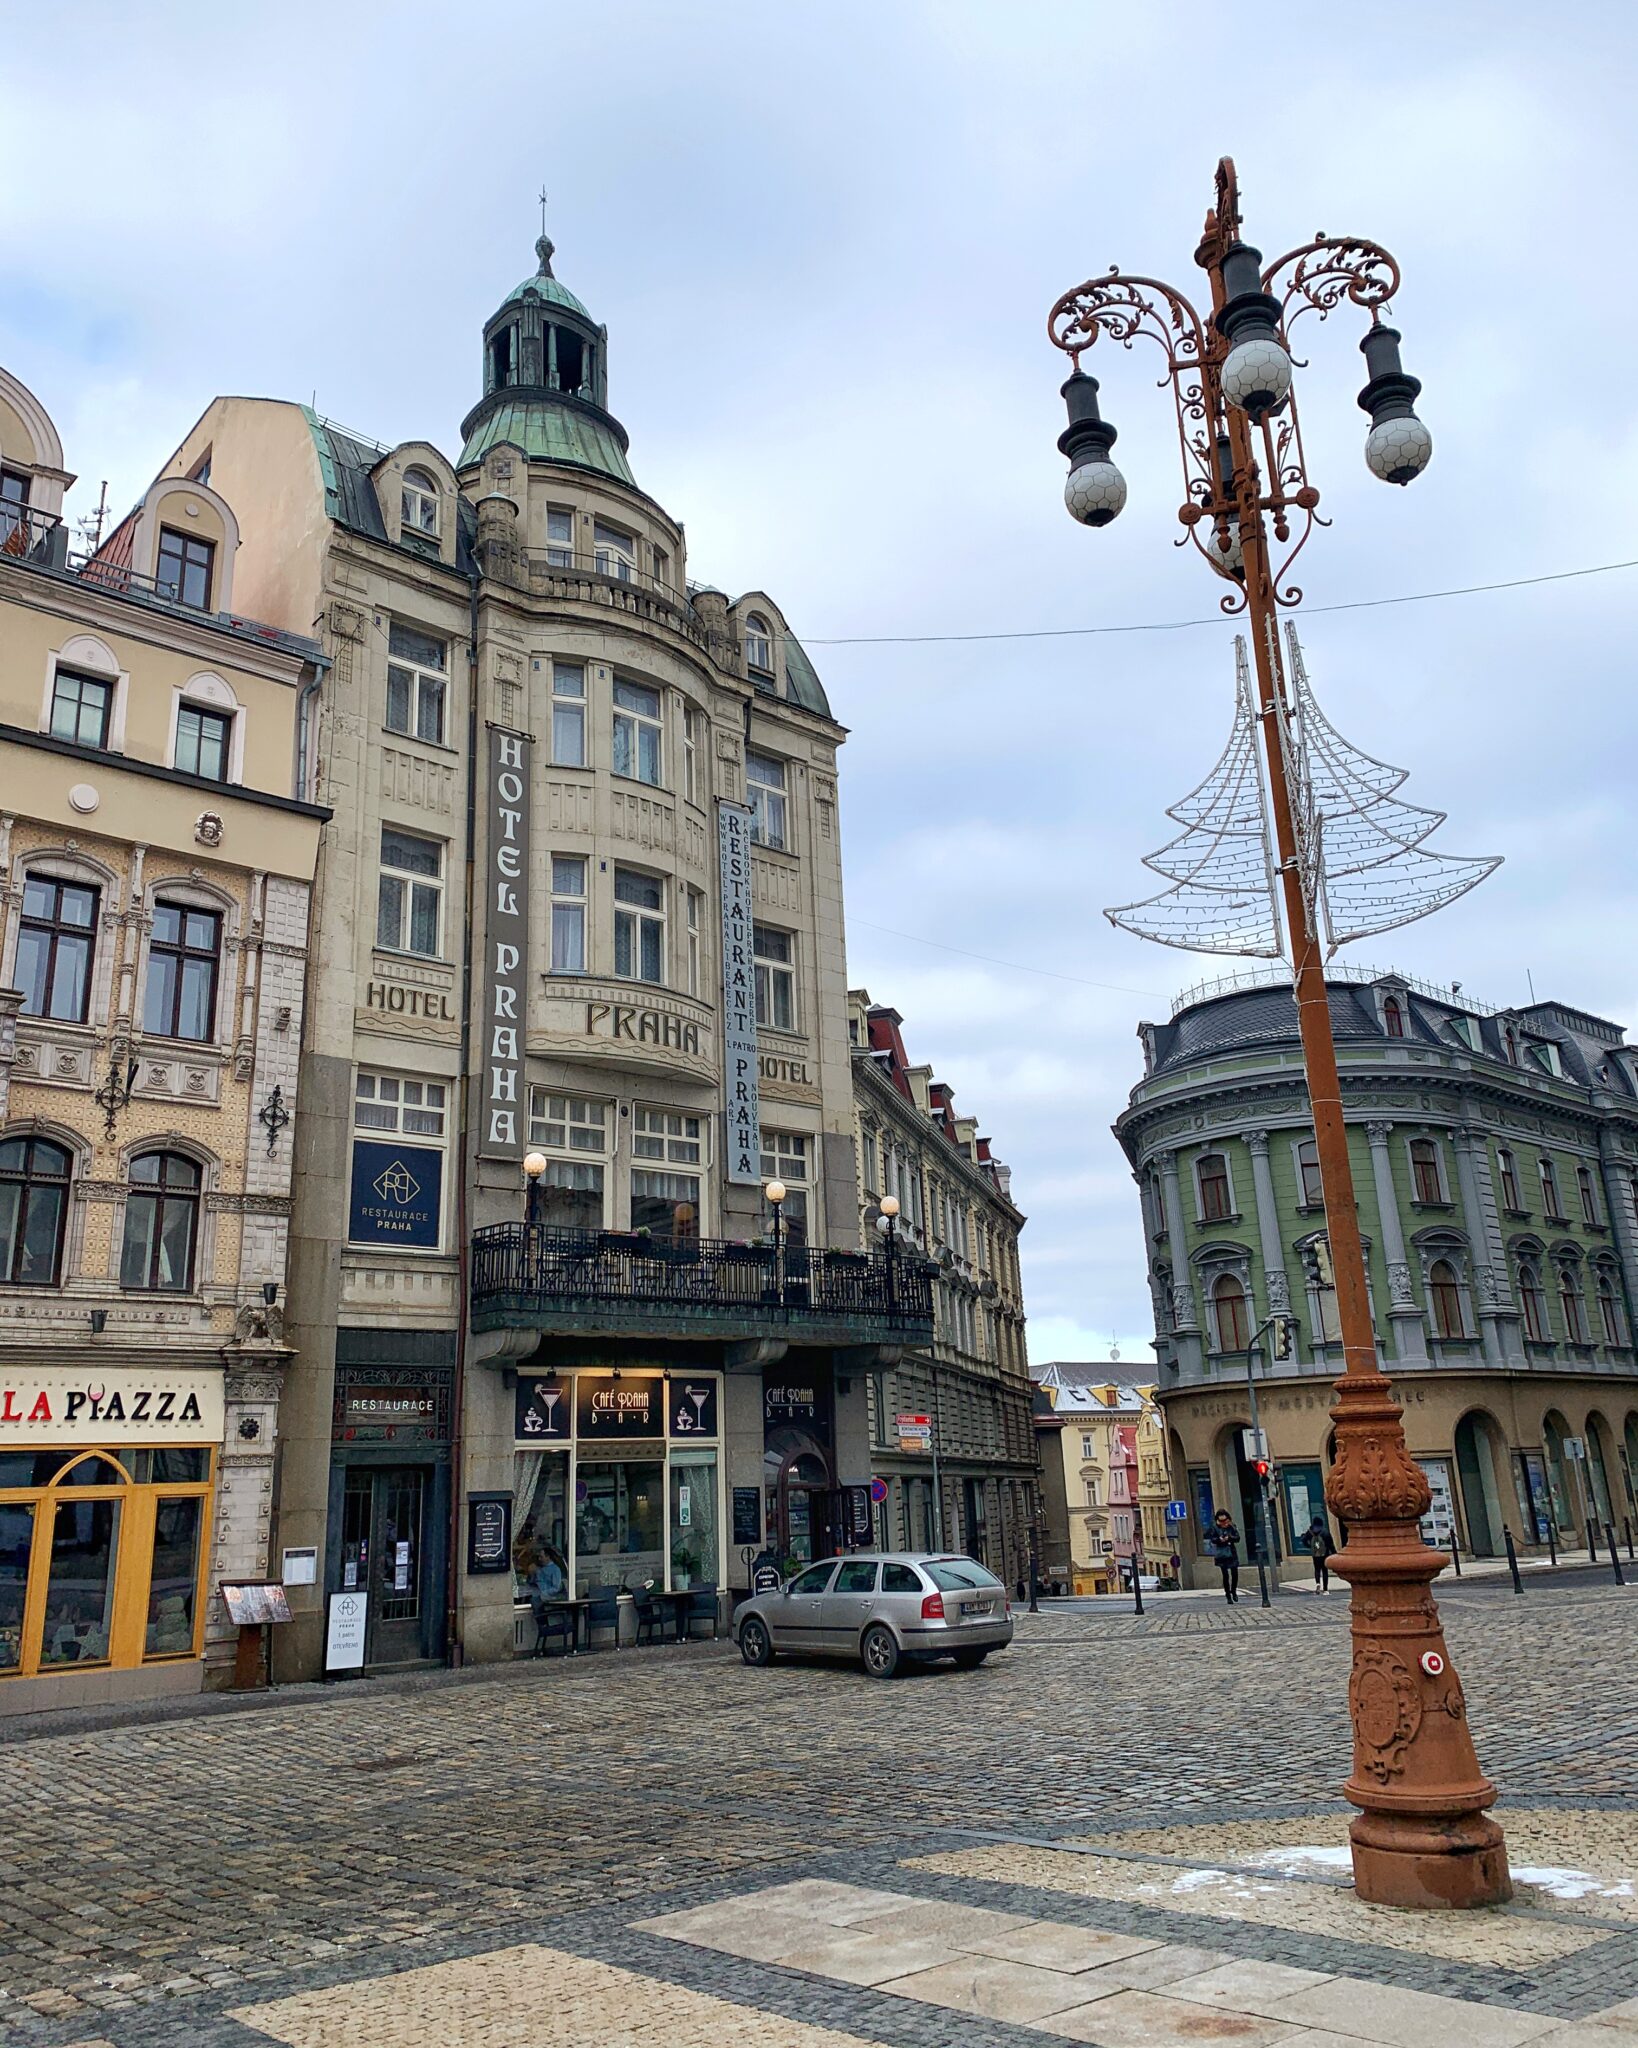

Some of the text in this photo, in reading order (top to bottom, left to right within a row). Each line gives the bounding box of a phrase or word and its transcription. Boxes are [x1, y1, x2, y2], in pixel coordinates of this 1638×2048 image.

[728, 815, 748, 1032] RESTAURANT
[488, 734, 524, 1145] HOTEL PRAHA
[366, 982, 456, 1021] HOTEL
[586, 1003, 699, 1056] PRAHA
[732, 1040, 756, 1053] PATRO
[736, 1058, 752, 1174] PRAHA
[361, 1207, 429, 1222] RESTAURACE
[376, 1220, 412, 1231] PRAHA
[1, 1383, 202, 1421] LA PIAZZA
[352, 1399, 434, 1411] RESTAURACE
[592, 1389, 649, 1410] CAFÉ PRAHA
[766, 1385, 814, 1405] CAFÉ PRAHA
